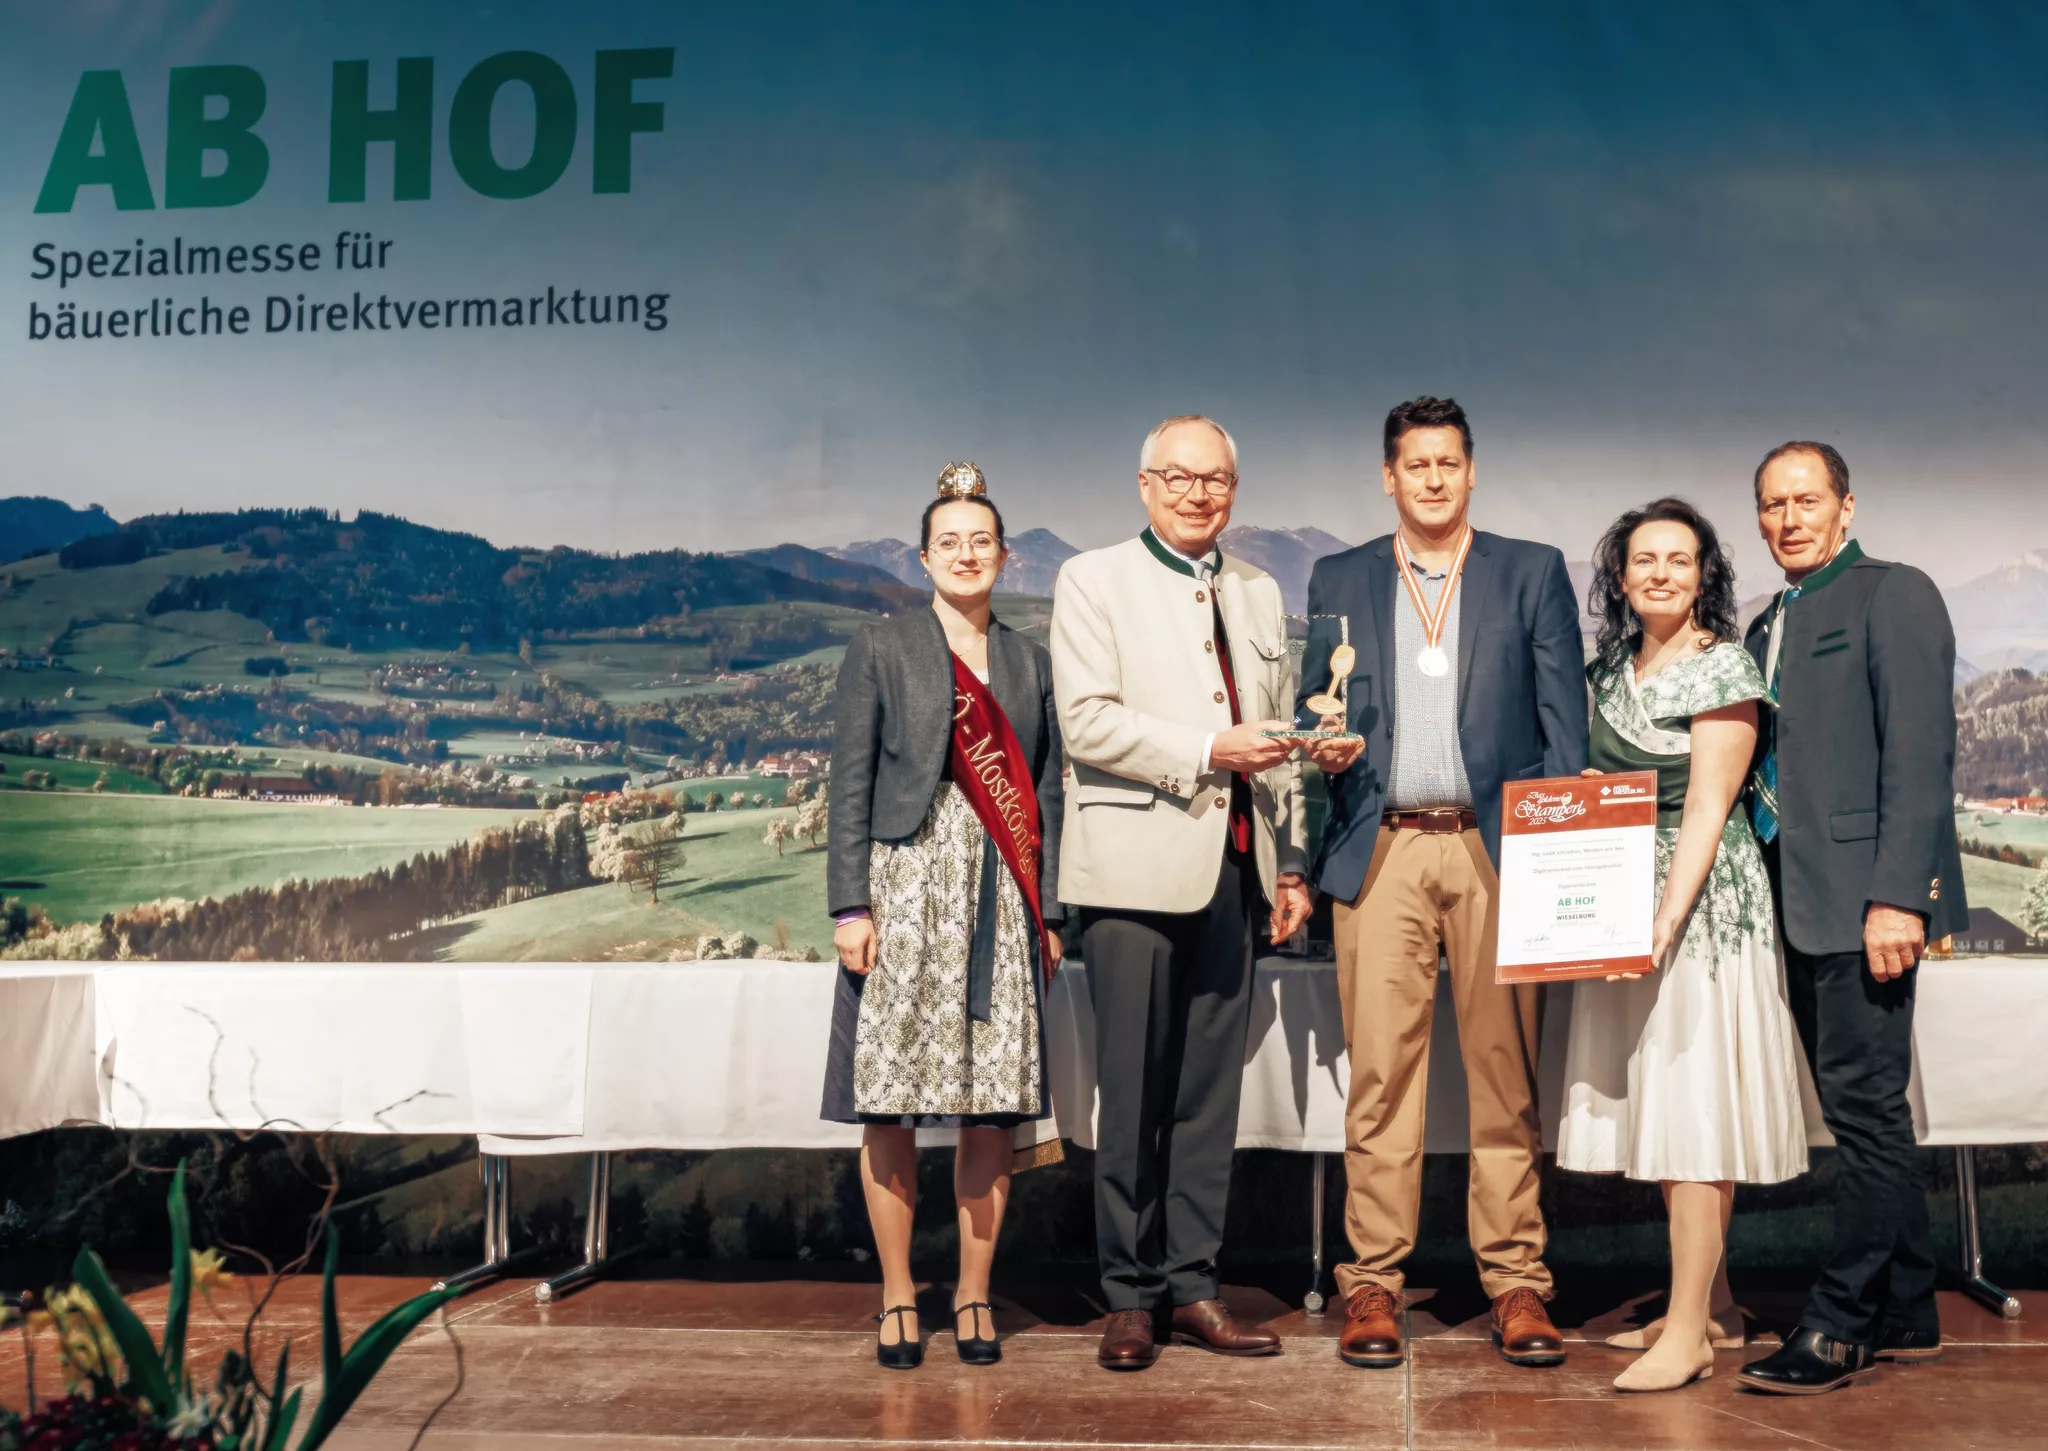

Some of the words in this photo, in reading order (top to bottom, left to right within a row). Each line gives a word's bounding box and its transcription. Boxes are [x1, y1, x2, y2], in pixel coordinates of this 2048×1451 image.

[33, 64, 271, 214] AB
[328, 47, 675, 203] HOF
[30, 237, 322, 289] Spezialmesse
[335, 231, 394, 270] für
[28, 297, 250, 341] bäuerliche
[264, 286, 671, 335] Direktvermarktung
[1528, 817, 1548, 825] 2025
[1556, 912, 1596, 921] WIESELBURG
[1557, 897, 1572, 907] AB
[1575, 896, 1596, 906] HOF
